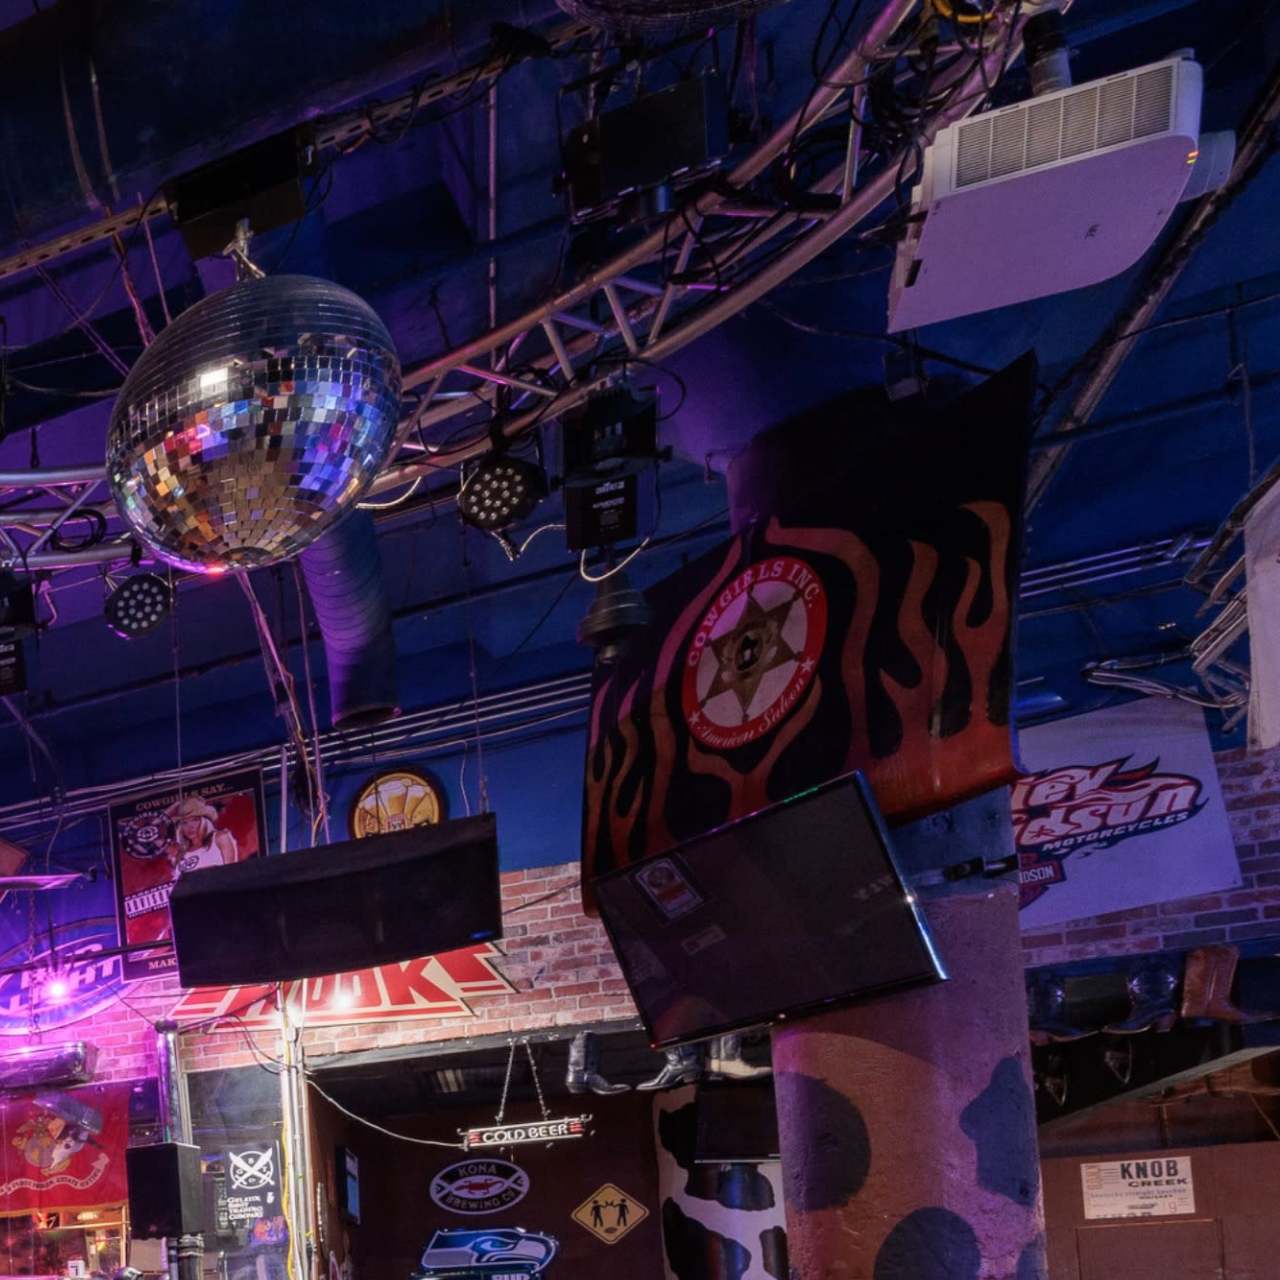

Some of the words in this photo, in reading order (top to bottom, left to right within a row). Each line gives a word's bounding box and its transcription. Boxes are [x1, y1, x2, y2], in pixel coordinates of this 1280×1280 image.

[787, 562, 820, 609] INC.
[1042, 811, 1189, 853] MOTORCYCLES
[482, 1128, 526, 1144] COLD
[527, 1122, 569, 1139] BEER
[457, 1163, 498, 1178] KONA
[1120, 1159, 1179, 1180] KNOB
[1128, 1177, 1188, 1188] CREEK
[445, 1194, 502, 1210] BREWING
